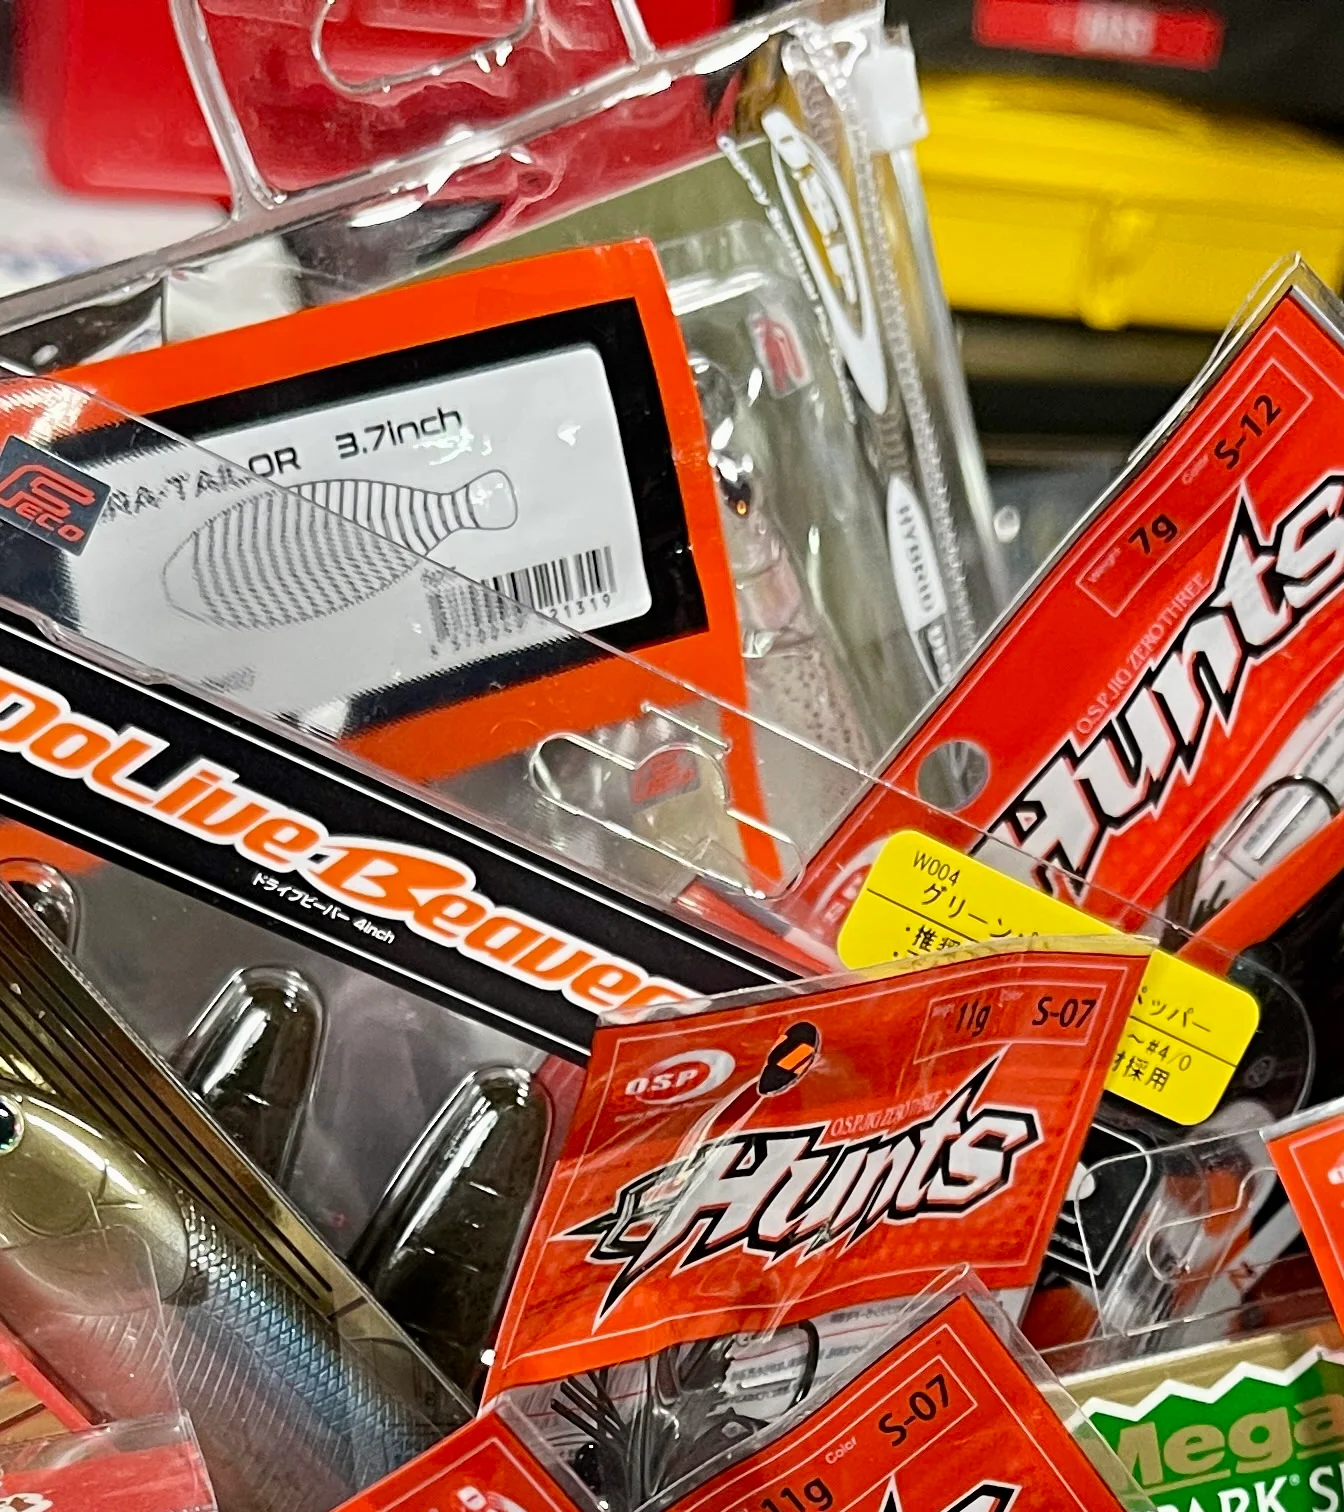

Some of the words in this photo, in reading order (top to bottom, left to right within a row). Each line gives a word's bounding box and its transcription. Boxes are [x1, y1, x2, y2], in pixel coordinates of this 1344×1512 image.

[335, 404, 464, 461] 3.7inch
[1207, 389, 1286, 472] S-12
[1126, 506, 1182, 563] 7g
[912, 850, 961, 887] W004
[353, 916, 397, 946] 4inch
[1031, 996, 1097, 1028] S-07
[586, 1044, 1043, 1331] Hunts
[879, 1373, 952, 1447] S-07
